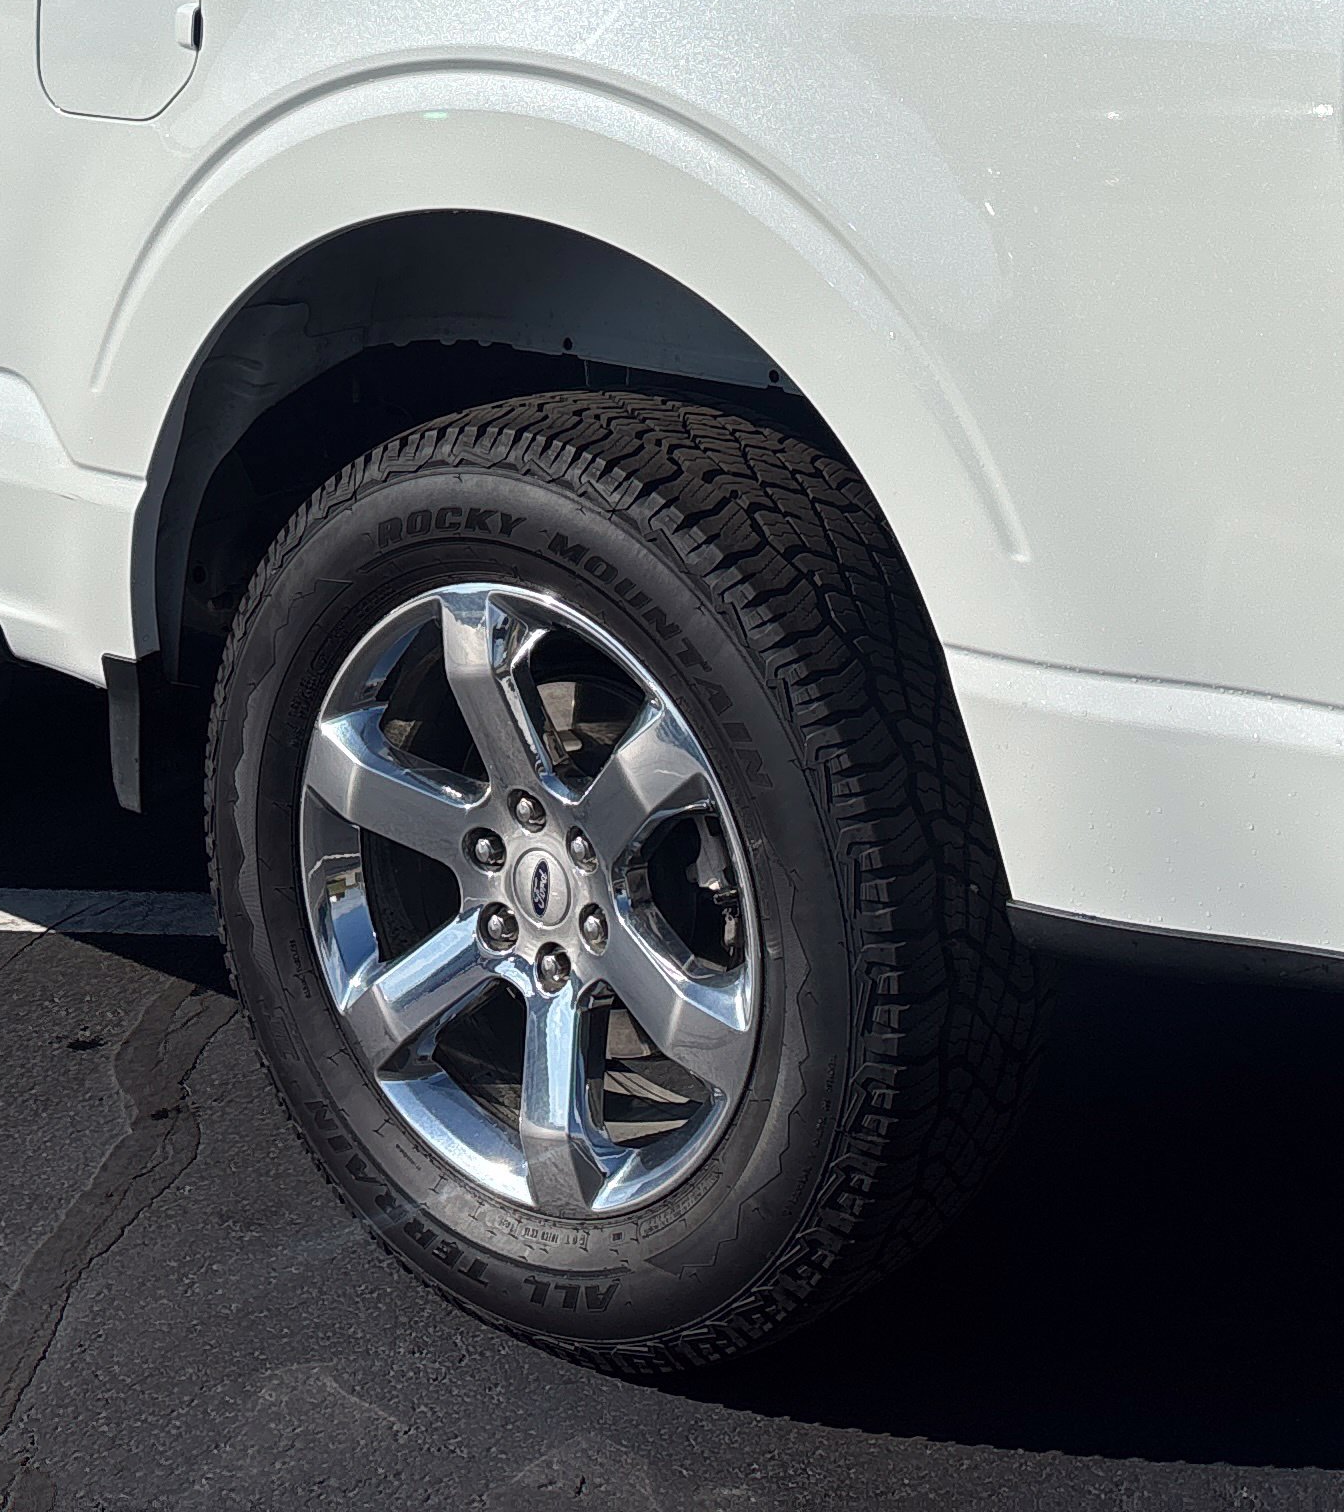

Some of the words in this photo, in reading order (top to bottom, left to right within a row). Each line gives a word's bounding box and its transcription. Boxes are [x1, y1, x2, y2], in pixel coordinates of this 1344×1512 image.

[377, 506, 528, 548] ROCKY
[545, 531, 774, 788] MOUNTAIN
[303, 1100, 489, 1287] TERRAIN
[522, 1275, 622, 1313] ALL
